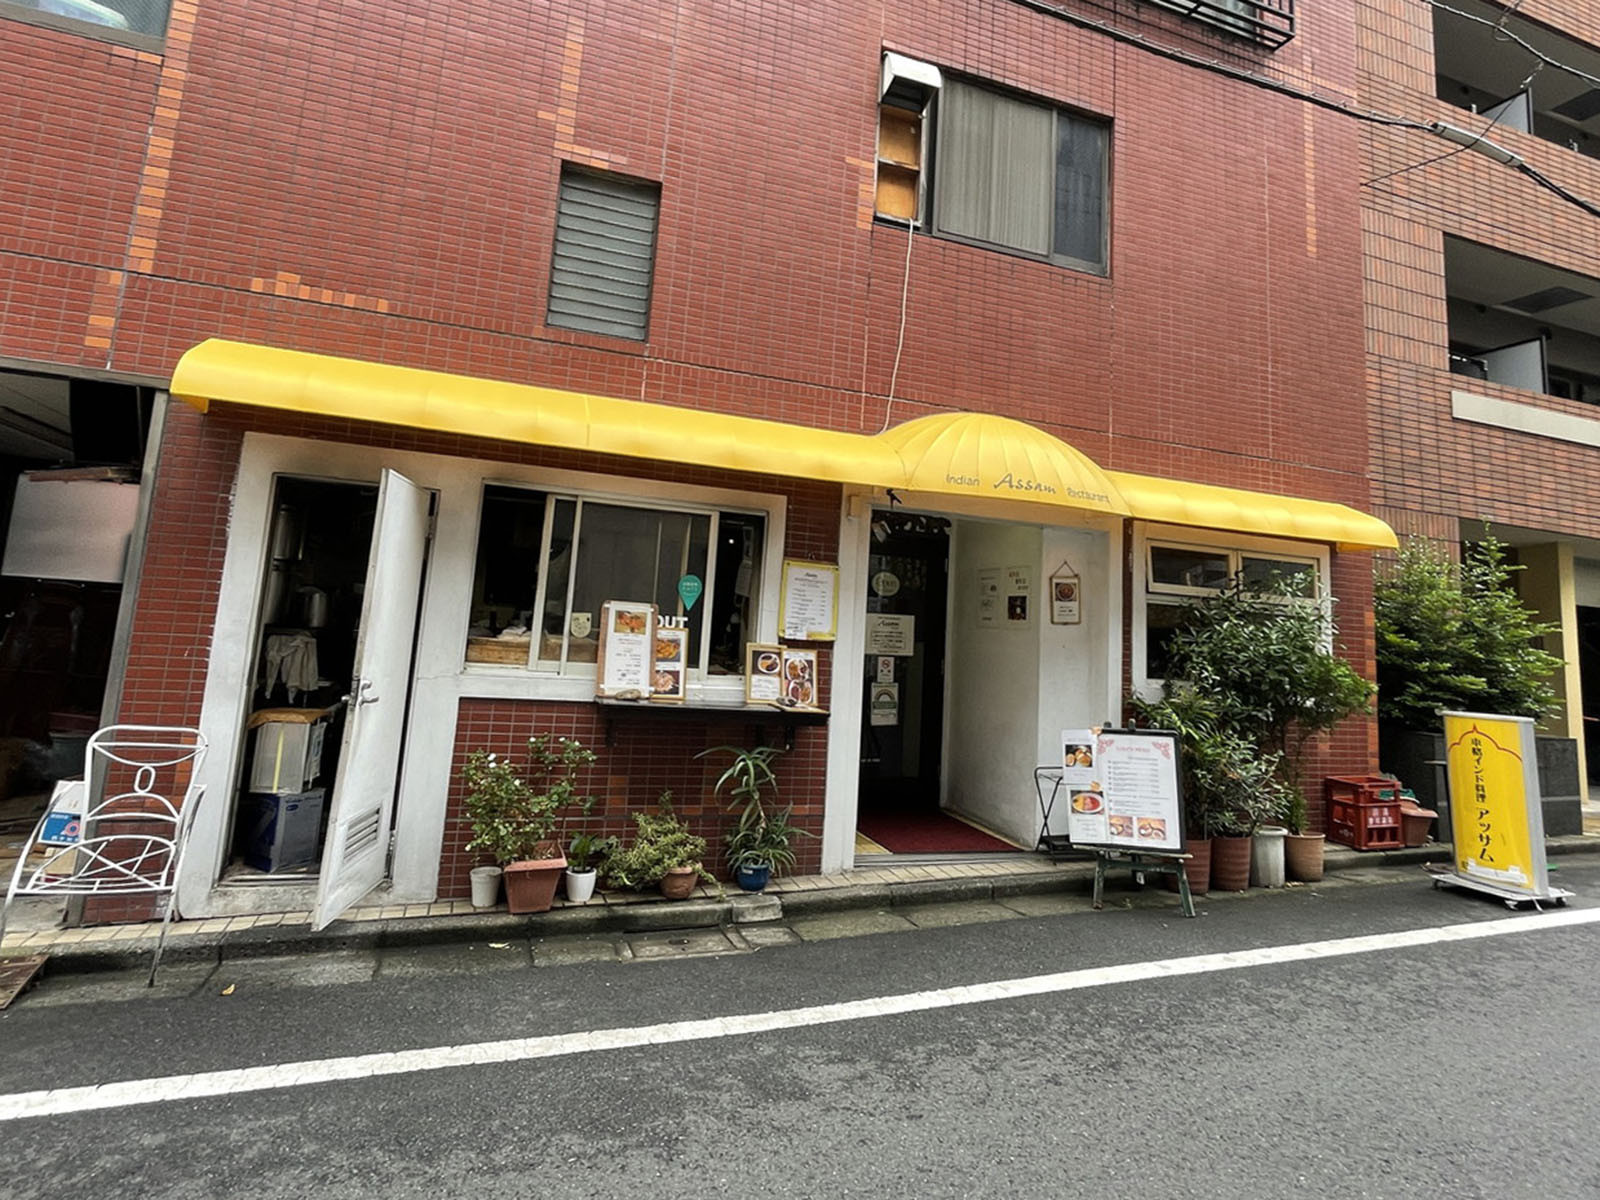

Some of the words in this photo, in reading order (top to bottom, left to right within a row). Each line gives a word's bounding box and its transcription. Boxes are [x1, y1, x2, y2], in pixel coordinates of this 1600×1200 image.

[945, 473, 980, 487] Indian
[993, 472, 1057, 494] Assam
[1476, 806, 1495, 863] アッサム
